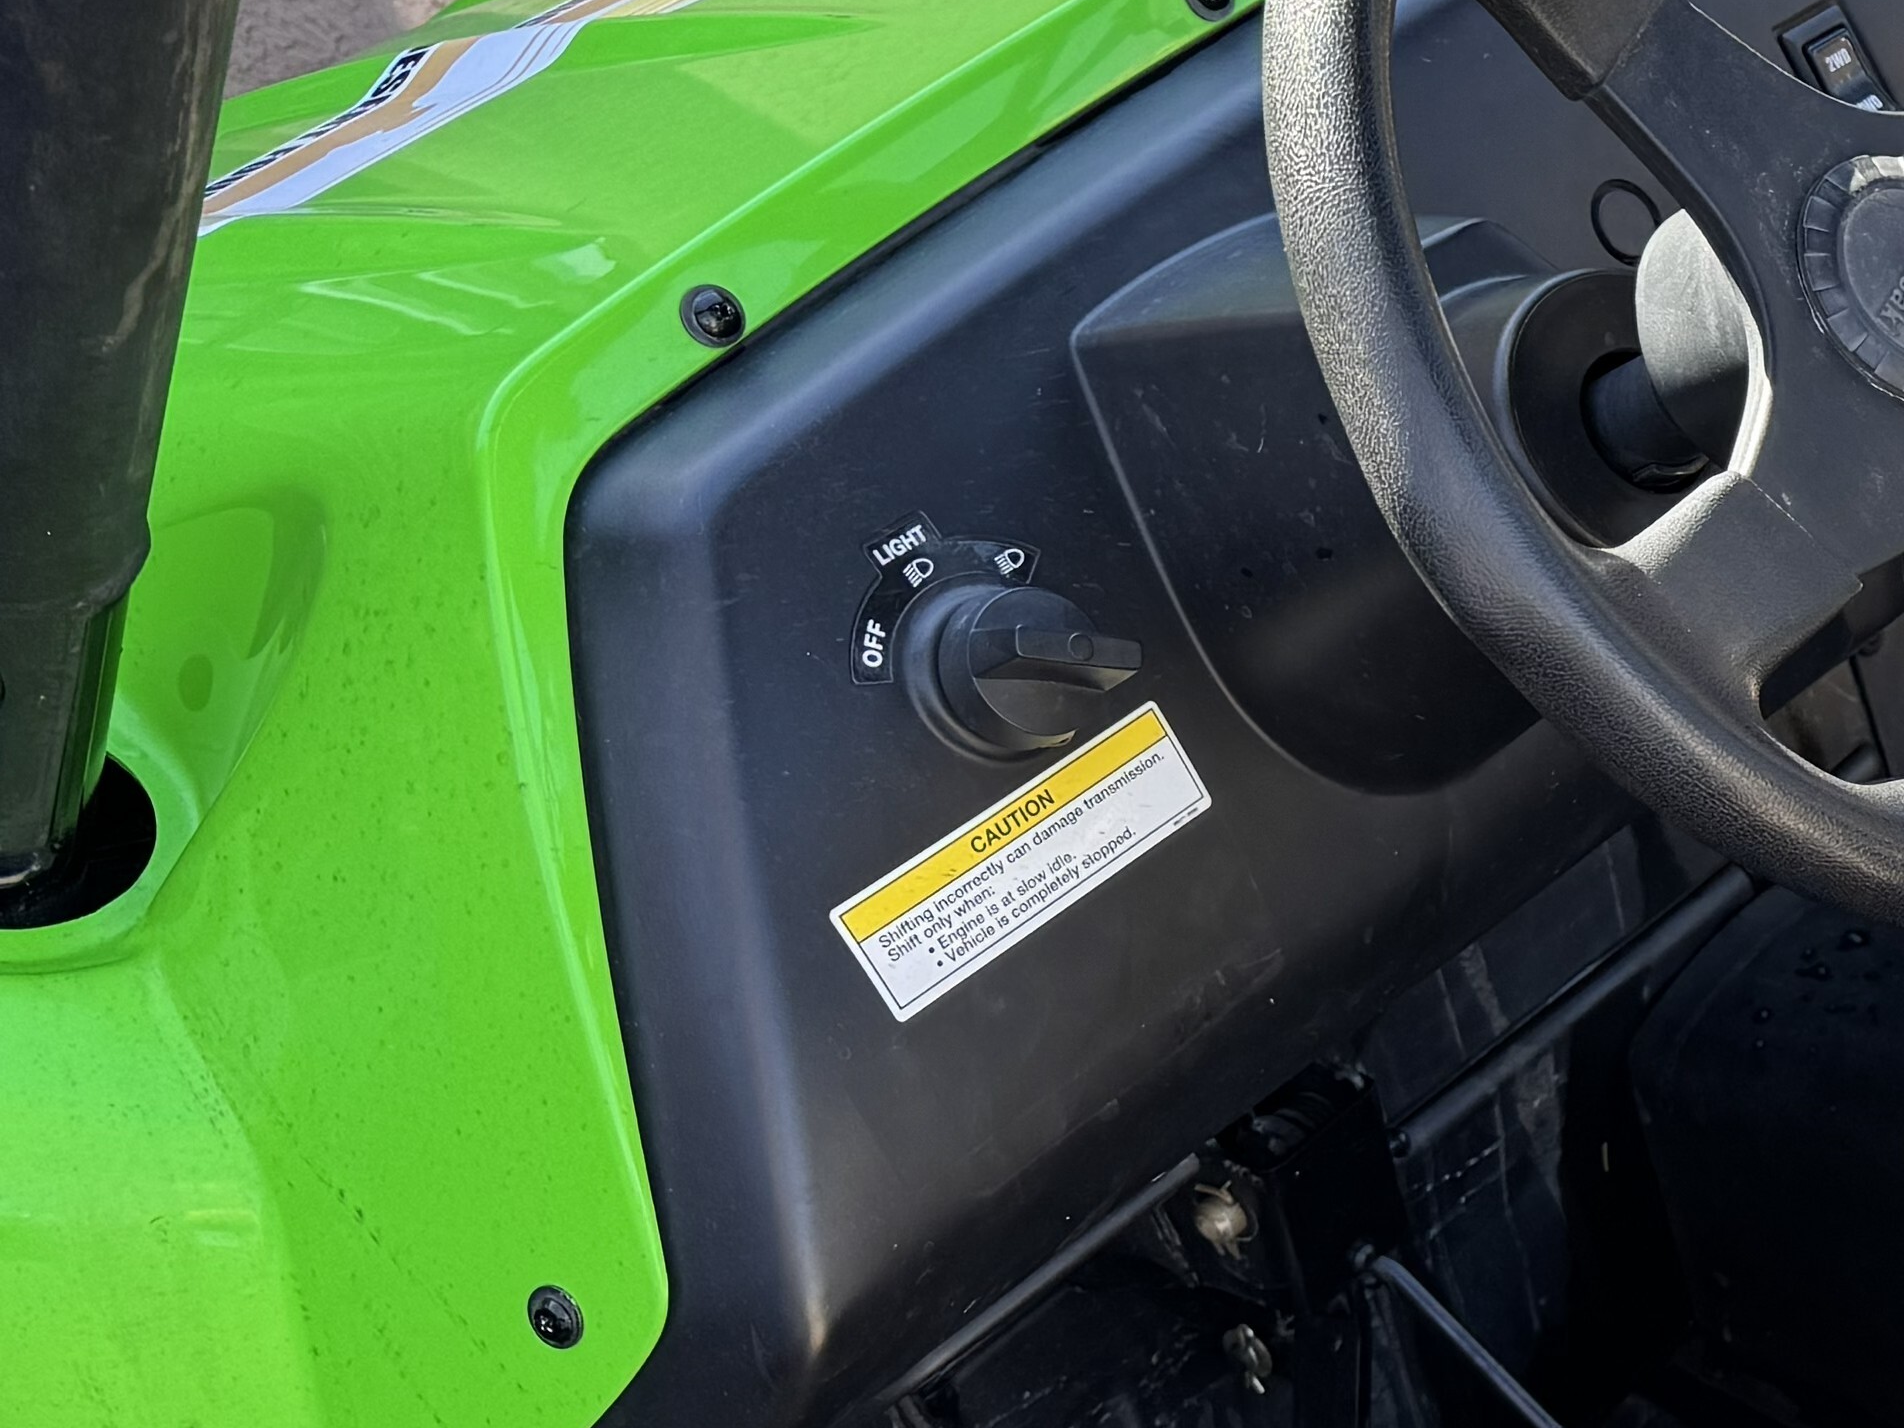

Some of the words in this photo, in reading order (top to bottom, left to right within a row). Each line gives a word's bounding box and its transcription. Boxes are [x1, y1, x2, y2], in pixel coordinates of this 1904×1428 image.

[1825, 47, 1852, 73] 2WD
[872, 524, 928, 566] LIGHT
[861, 619, 886, 668] OFF
[878, 908, 934, 948] Shifting
[932, 860, 1005, 913] incorrectly
[1006, 842, 1032, 863] can
[1032, 806, 1084, 845] damage
[1083, 752, 1165, 810] transmission.
[970, 788, 1055, 853] CAUTION
[888, 933, 922, 962] Shift
[923, 913, 953, 939] only
[953, 885, 996, 917] when:
[937, 913, 985, 950] Engine
[985, 902, 1000, 917] is
[1001, 890, 1016, 907] at
[1017, 869, 1047, 896] slow
[1046, 853, 1077, 874] idle.
[944, 924, 996, 962] Vehicle
[995, 914, 1010, 929] is
[1011, 865, 1080, 919] completely
[1082, 825, 1136, 869] stopped.
